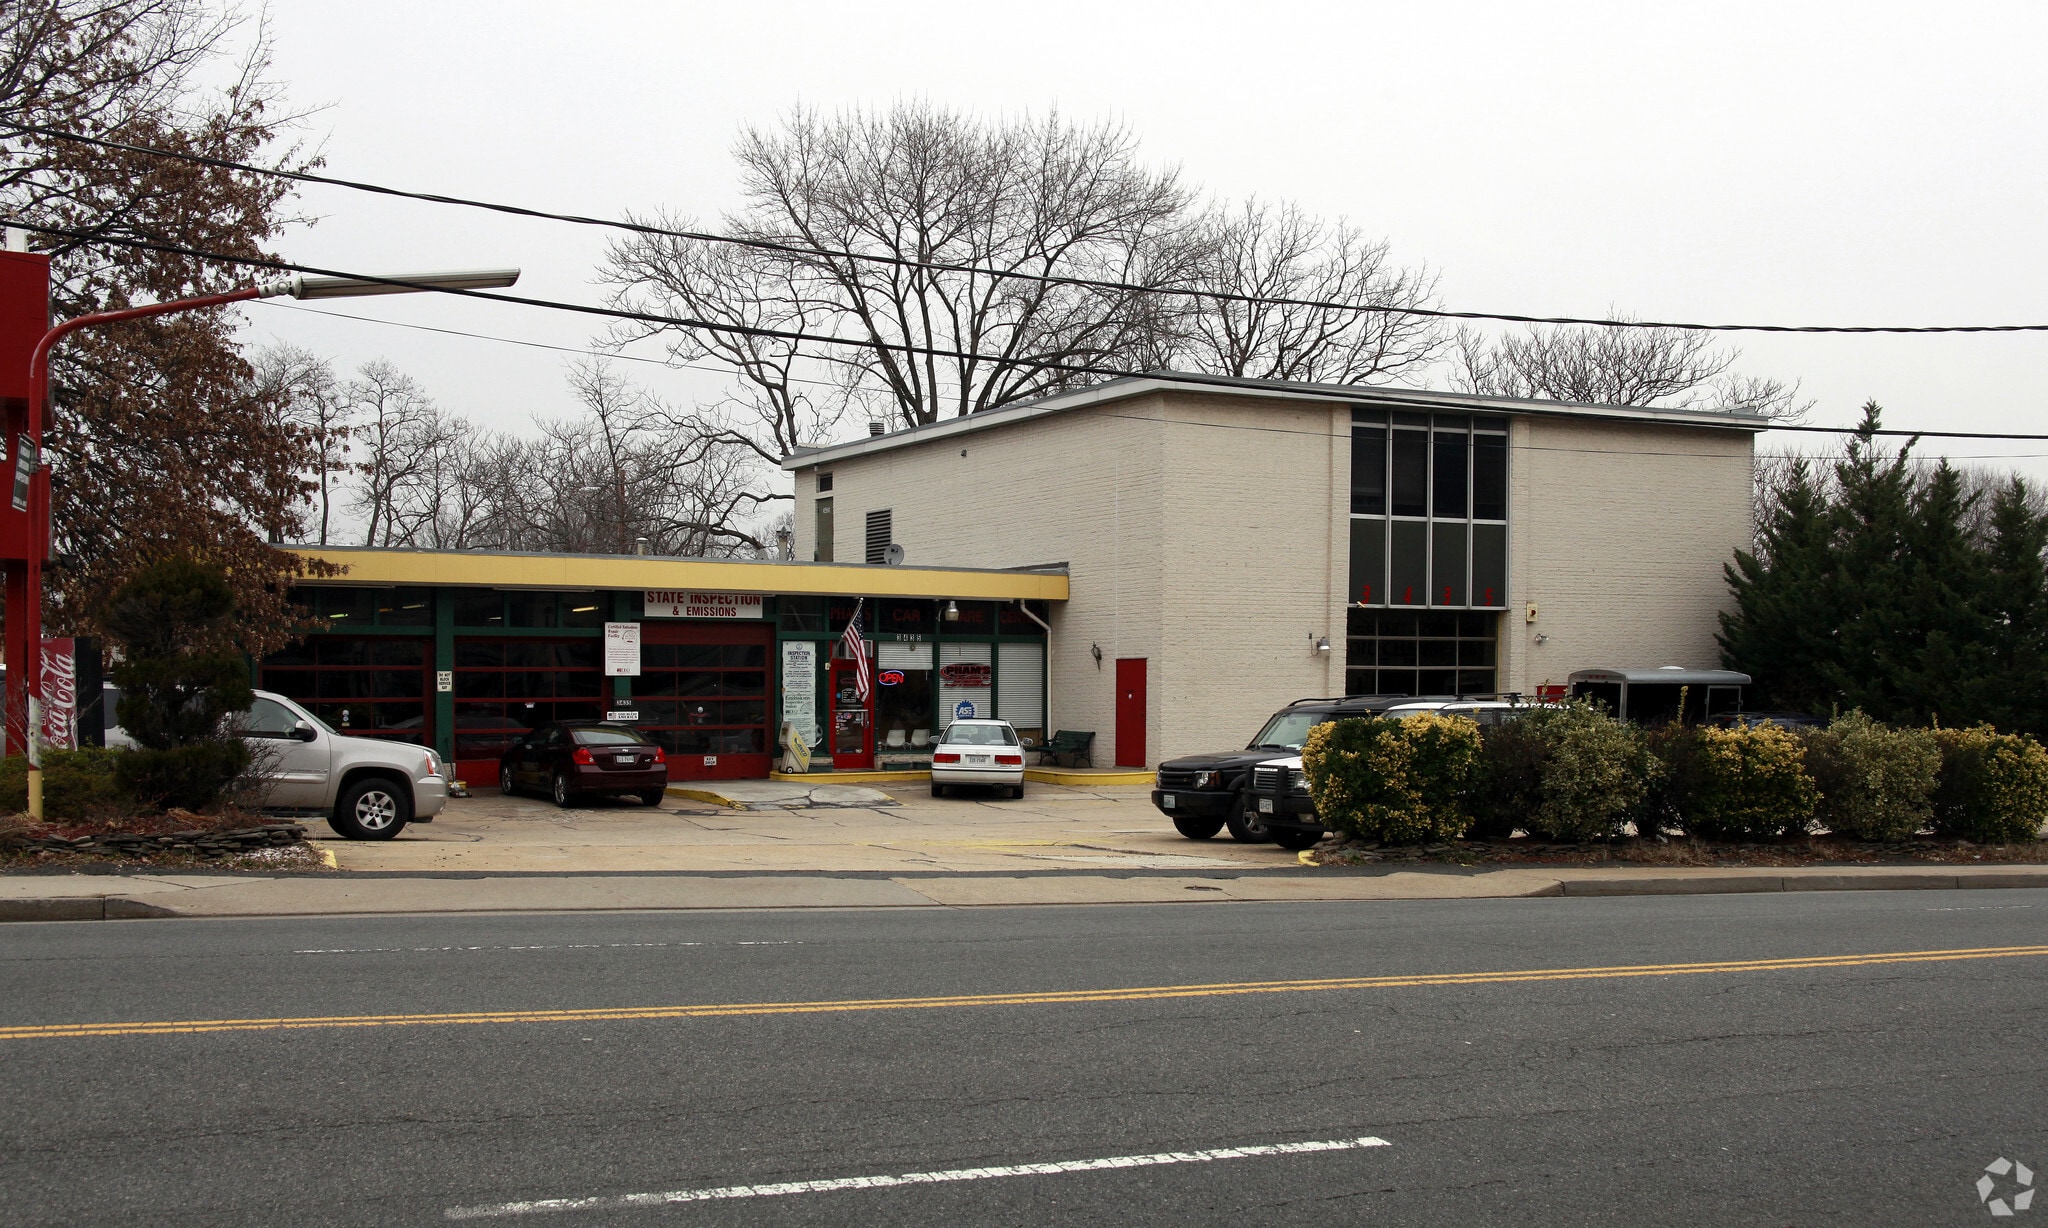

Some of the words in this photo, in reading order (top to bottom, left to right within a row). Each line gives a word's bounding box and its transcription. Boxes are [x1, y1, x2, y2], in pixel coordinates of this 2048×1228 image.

[647, 590, 684, 604] STATE
[690, 593, 760, 605] INSPECTION
[1362, 584, 1371, 605] 3
[1403, 585, 1413, 605] 4
[1443, 586, 1452, 605] 3
[1484, 587, 1494, 607] 5
[672, 605, 680, 616] &
[686, 606, 737, 617] EMISSIONS
[892, 608, 921, 622] CAR
[951, 610, 985, 623] ARE
[878, 672, 905, 685] OPEN
[958, 706, 972, 715] ASE
